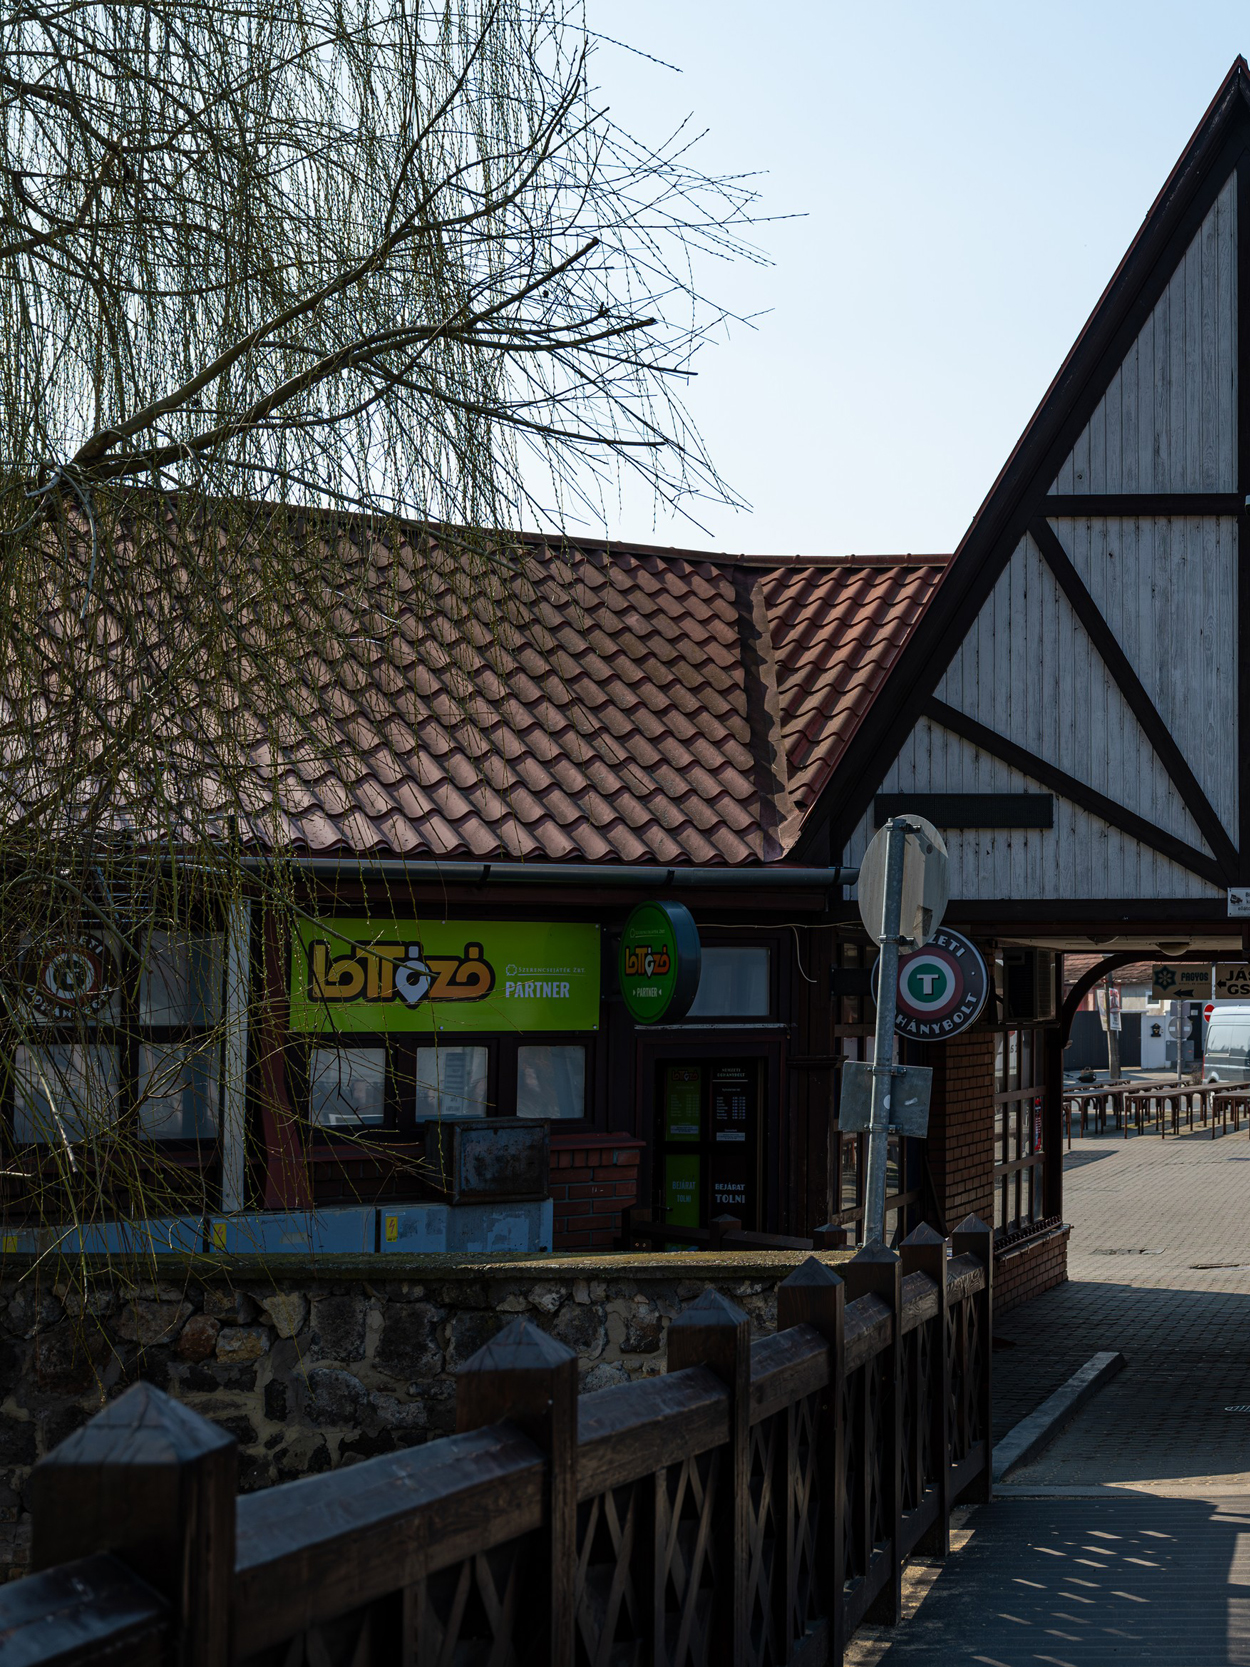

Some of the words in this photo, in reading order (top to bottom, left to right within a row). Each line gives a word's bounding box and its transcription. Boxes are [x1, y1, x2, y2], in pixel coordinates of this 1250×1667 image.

[505, 981, 570, 998] PARTNER
[916, 974, 940, 996] T
[636, 987, 658, 997] PARTNER
[896, 992, 978, 1034] HÁNYBOLT
[672, 1180, 697, 1190] BEJÁRAT
[715, 1182, 746, 1191] BEJÁRAT
[676, 1194, 692, 1203] TOLNI
[715, 1194, 746, 1204] TOLNI
